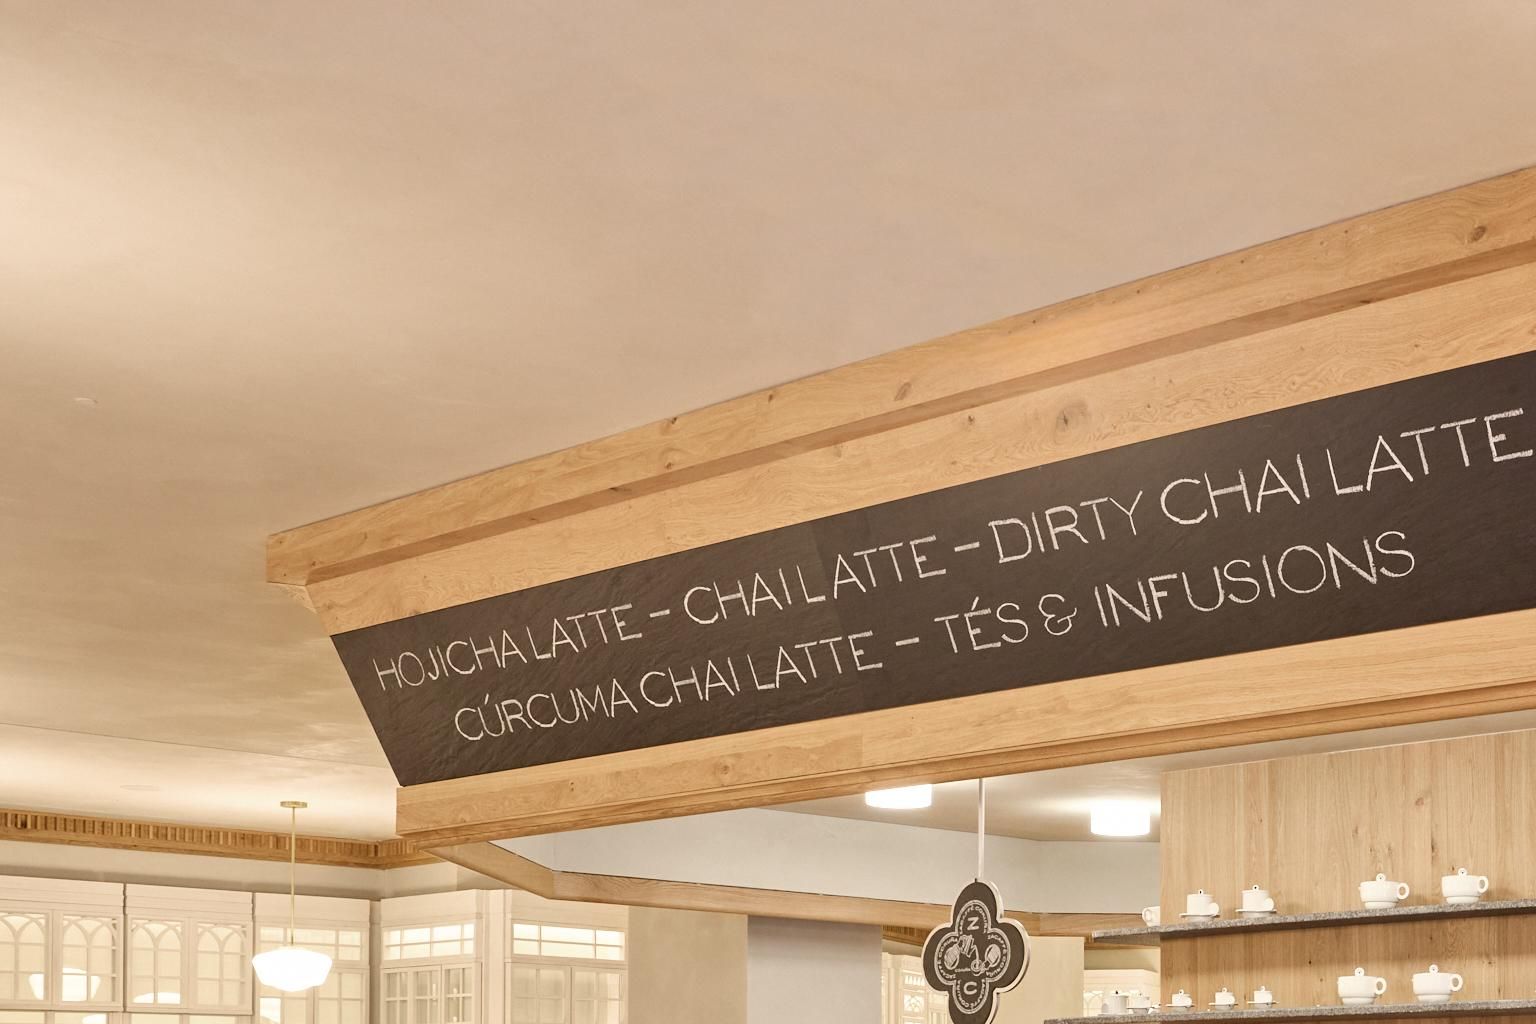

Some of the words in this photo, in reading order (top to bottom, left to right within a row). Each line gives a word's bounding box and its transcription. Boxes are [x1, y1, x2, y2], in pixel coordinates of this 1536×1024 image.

[373, 629, 527, 690] HOJICHA
[527, 604, 642, 660] LATTE
[684, 569, 791, 624] CHAI
[797, 535, 946, 603] LATTE
[988, 491, 1142, 563] DIRTY
[1160, 454, 1310, 524] CHAI
[1327, 408, 1533, 495] LATTE
[455, 678, 638, 740] CÚRCUMA
[640, 656, 740, 707] CHAI
[747, 631, 882, 690] LATTE
[934, 597, 1028, 653] TÉS
[1039, 594, 1077, 635] &
[1095, 530, 1414, 627] INFUSIONS
[967, 916, 980, 930] Z
[963, 981, 978, 995] C
